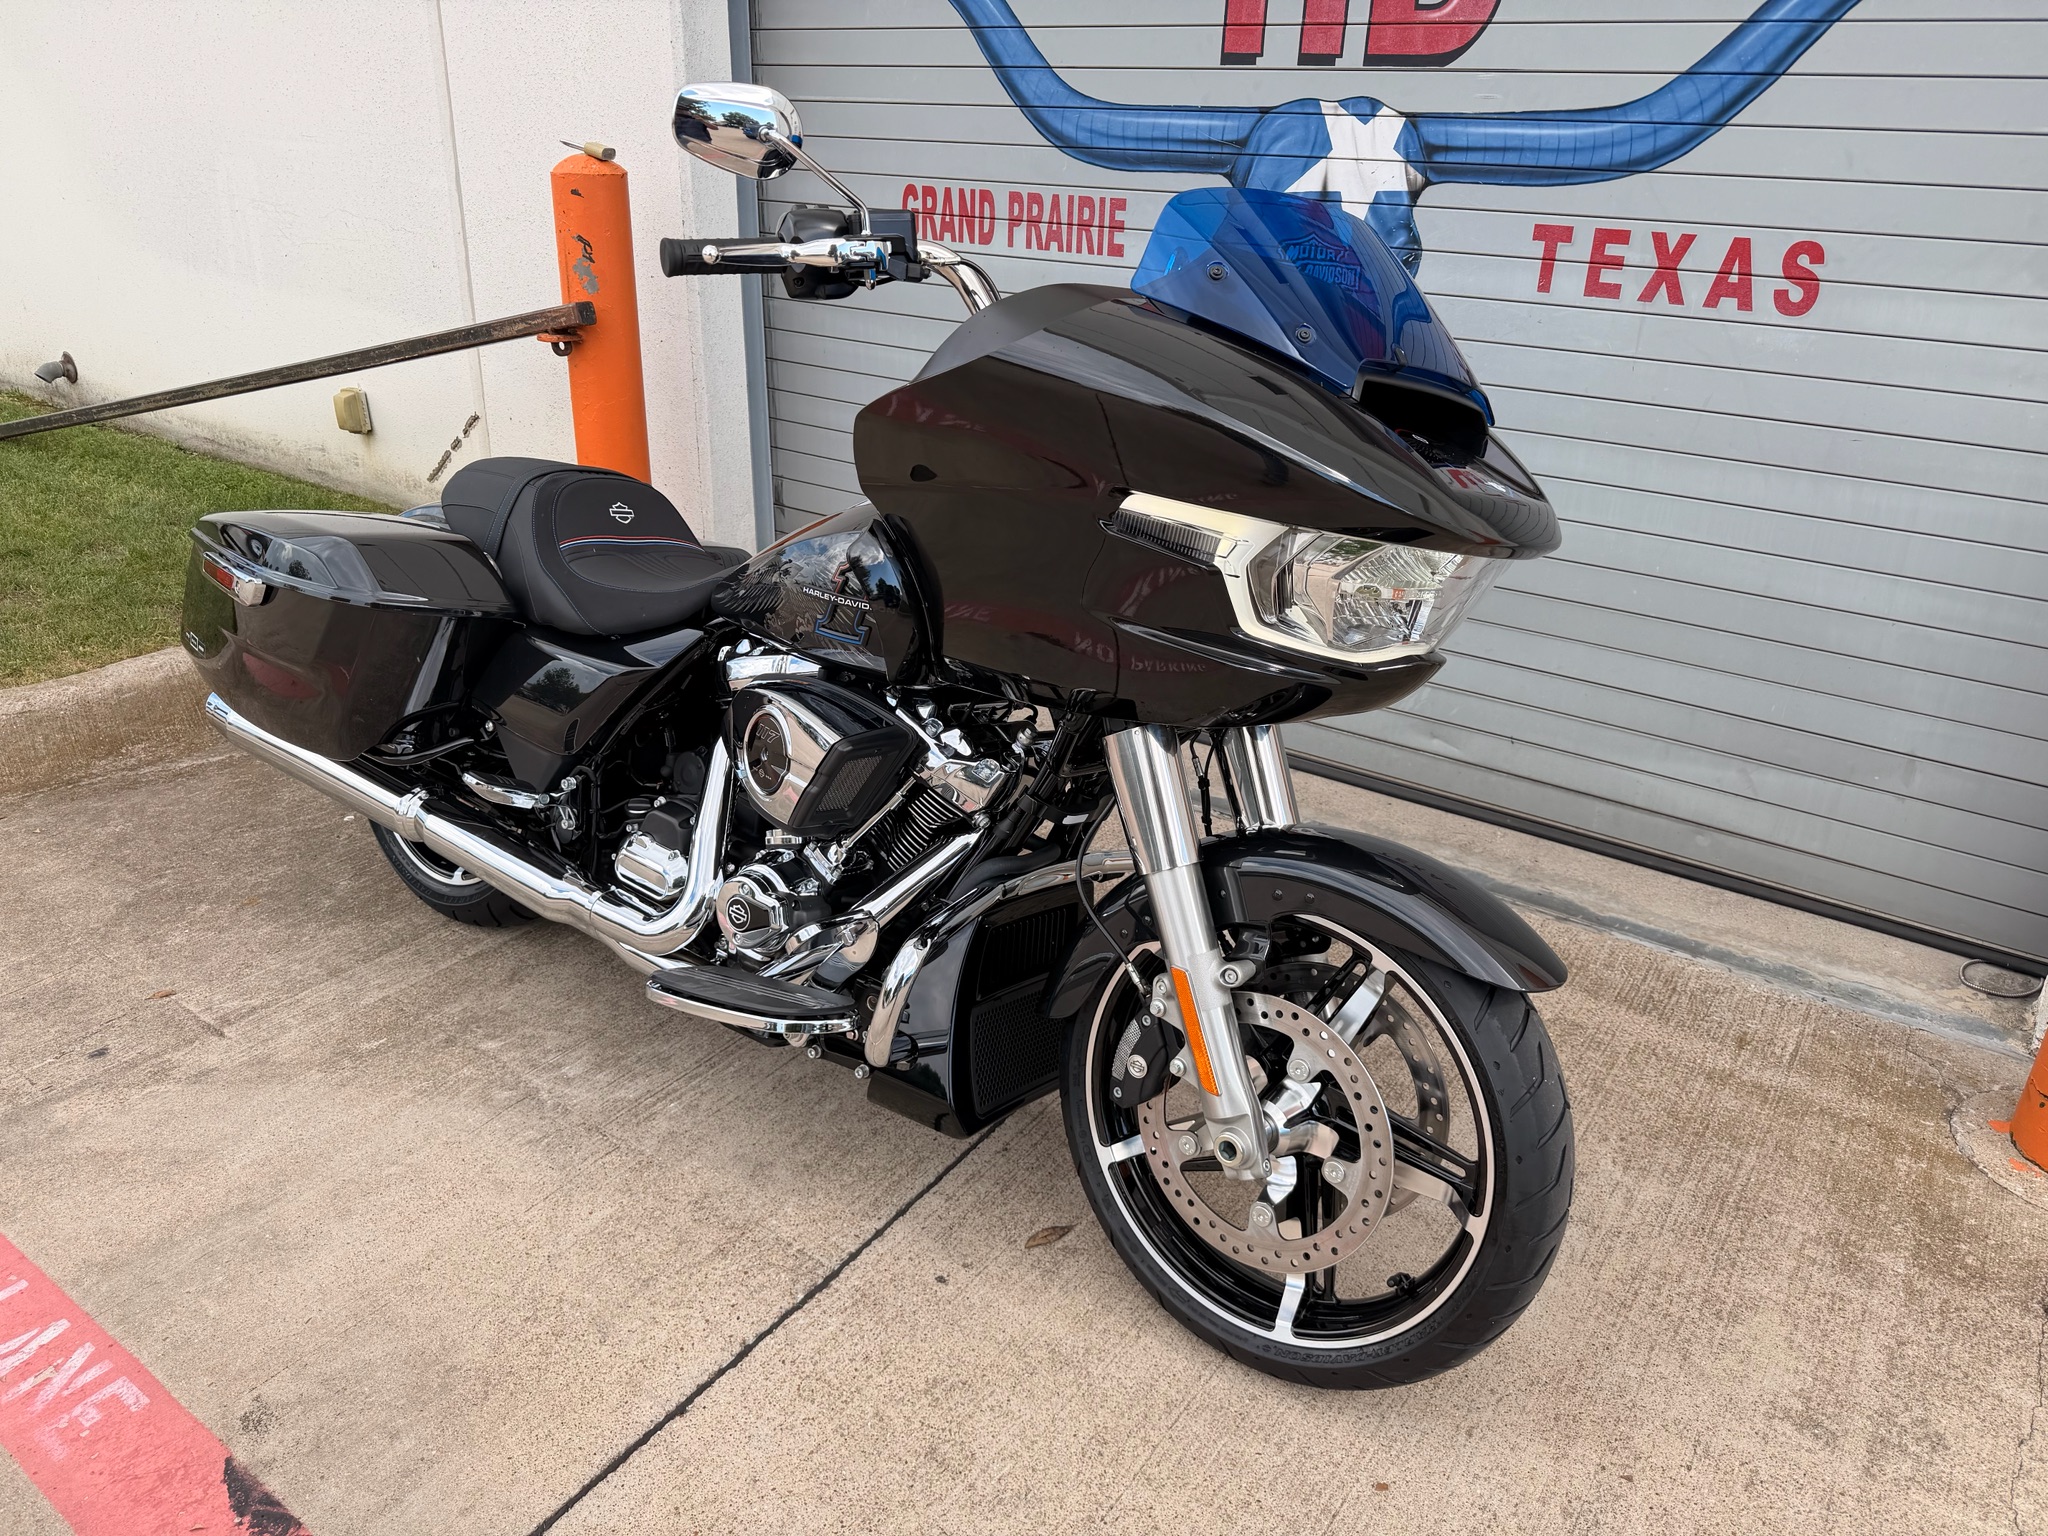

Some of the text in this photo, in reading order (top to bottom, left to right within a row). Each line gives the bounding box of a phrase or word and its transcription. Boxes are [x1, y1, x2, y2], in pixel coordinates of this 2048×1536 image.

[901, 183, 1127, 258] GRAND PRAIRIE
[1531, 223, 1826, 317] TEXAS
[802, 586, 892, 613] HARLEY-DAVID
[756, 723, 781, 743] 117
